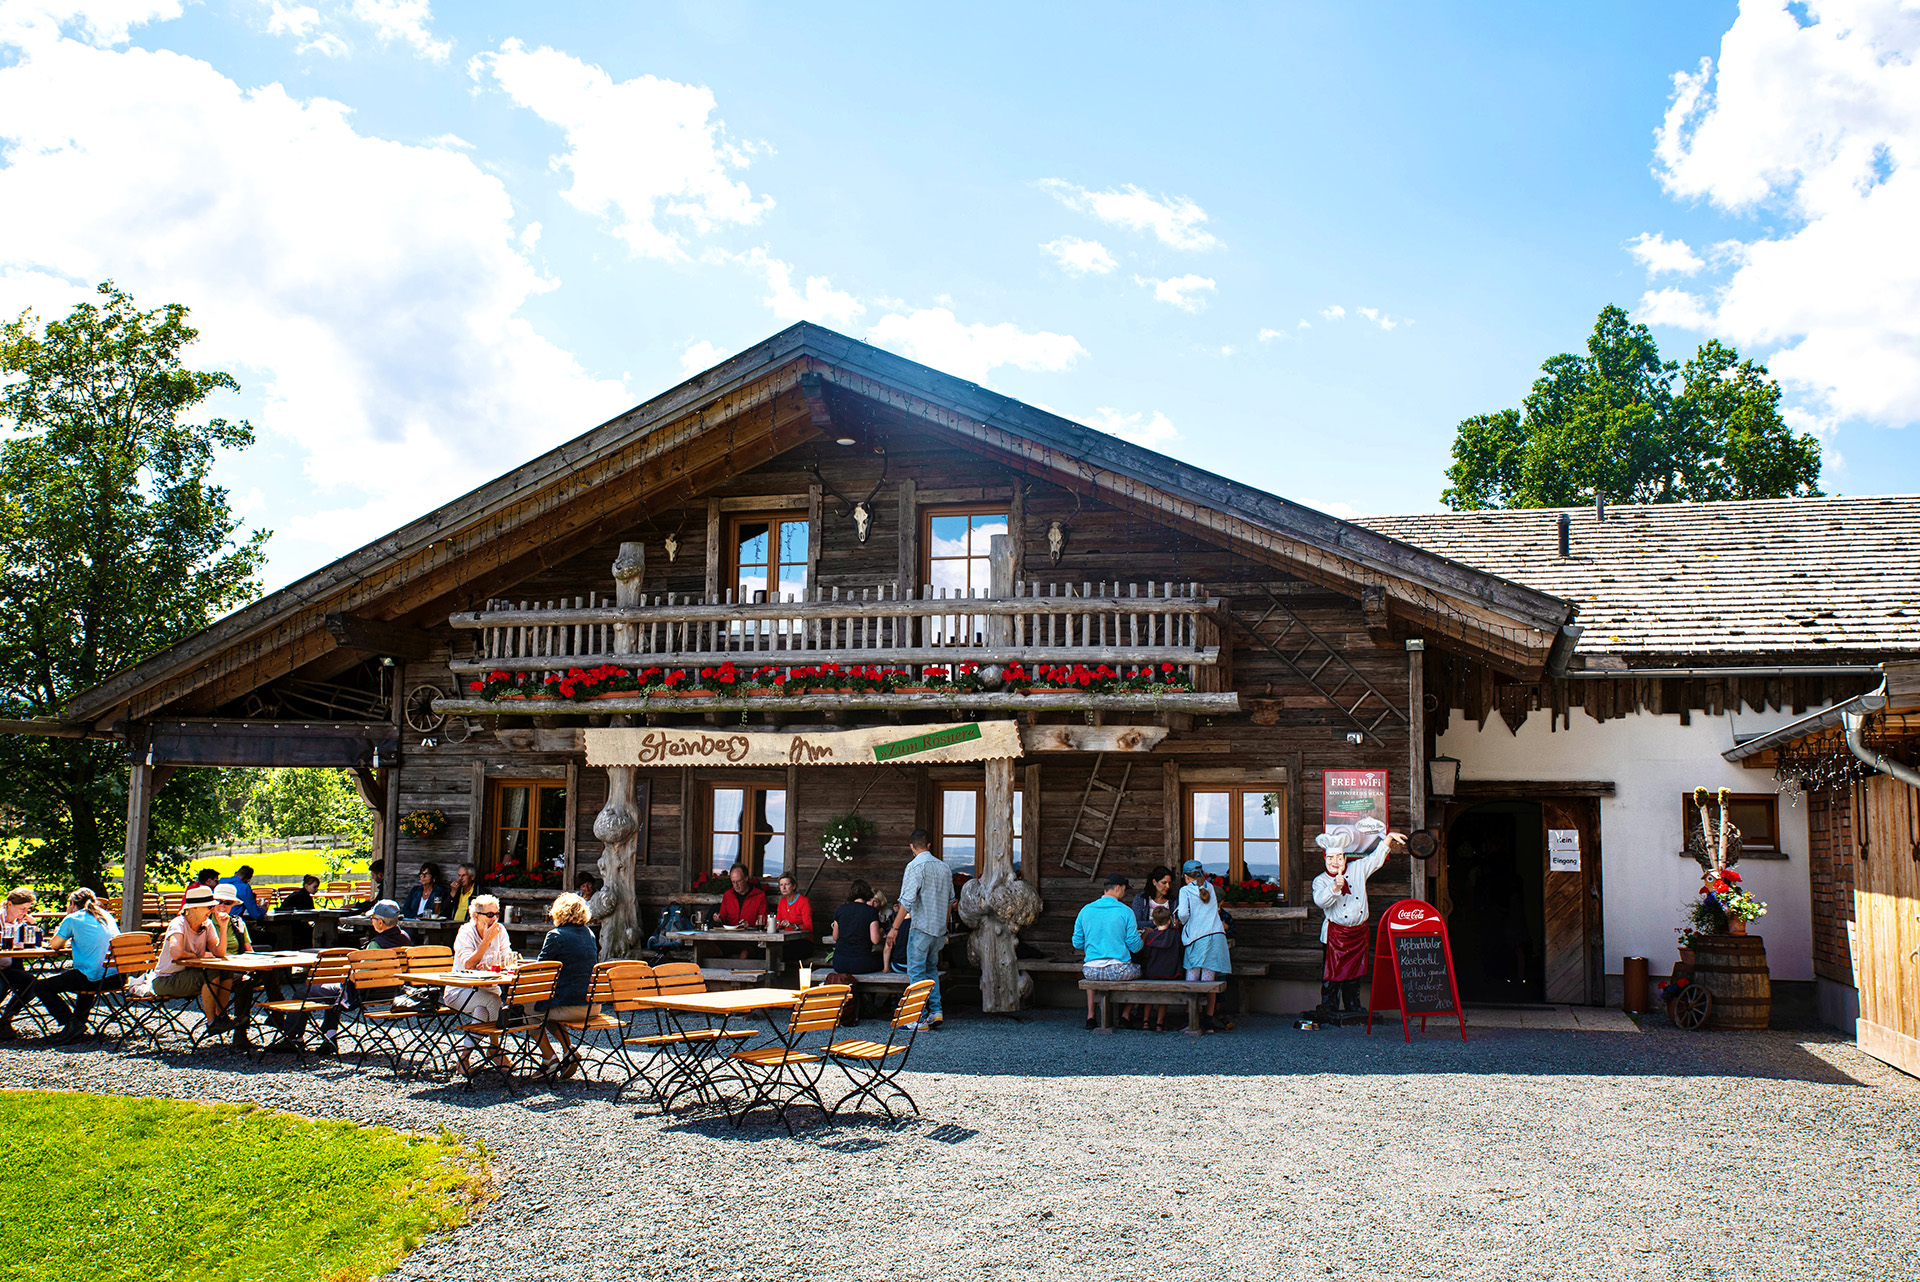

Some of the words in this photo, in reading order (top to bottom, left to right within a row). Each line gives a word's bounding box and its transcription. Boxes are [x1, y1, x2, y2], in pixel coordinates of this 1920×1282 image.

[922, 729, 976, 750] Rösner«
[638, 731, 750, 763] Steinberg
[1331, 778, 1357, 786] FREE
[1552, 857, 1577, 865] Eingang
